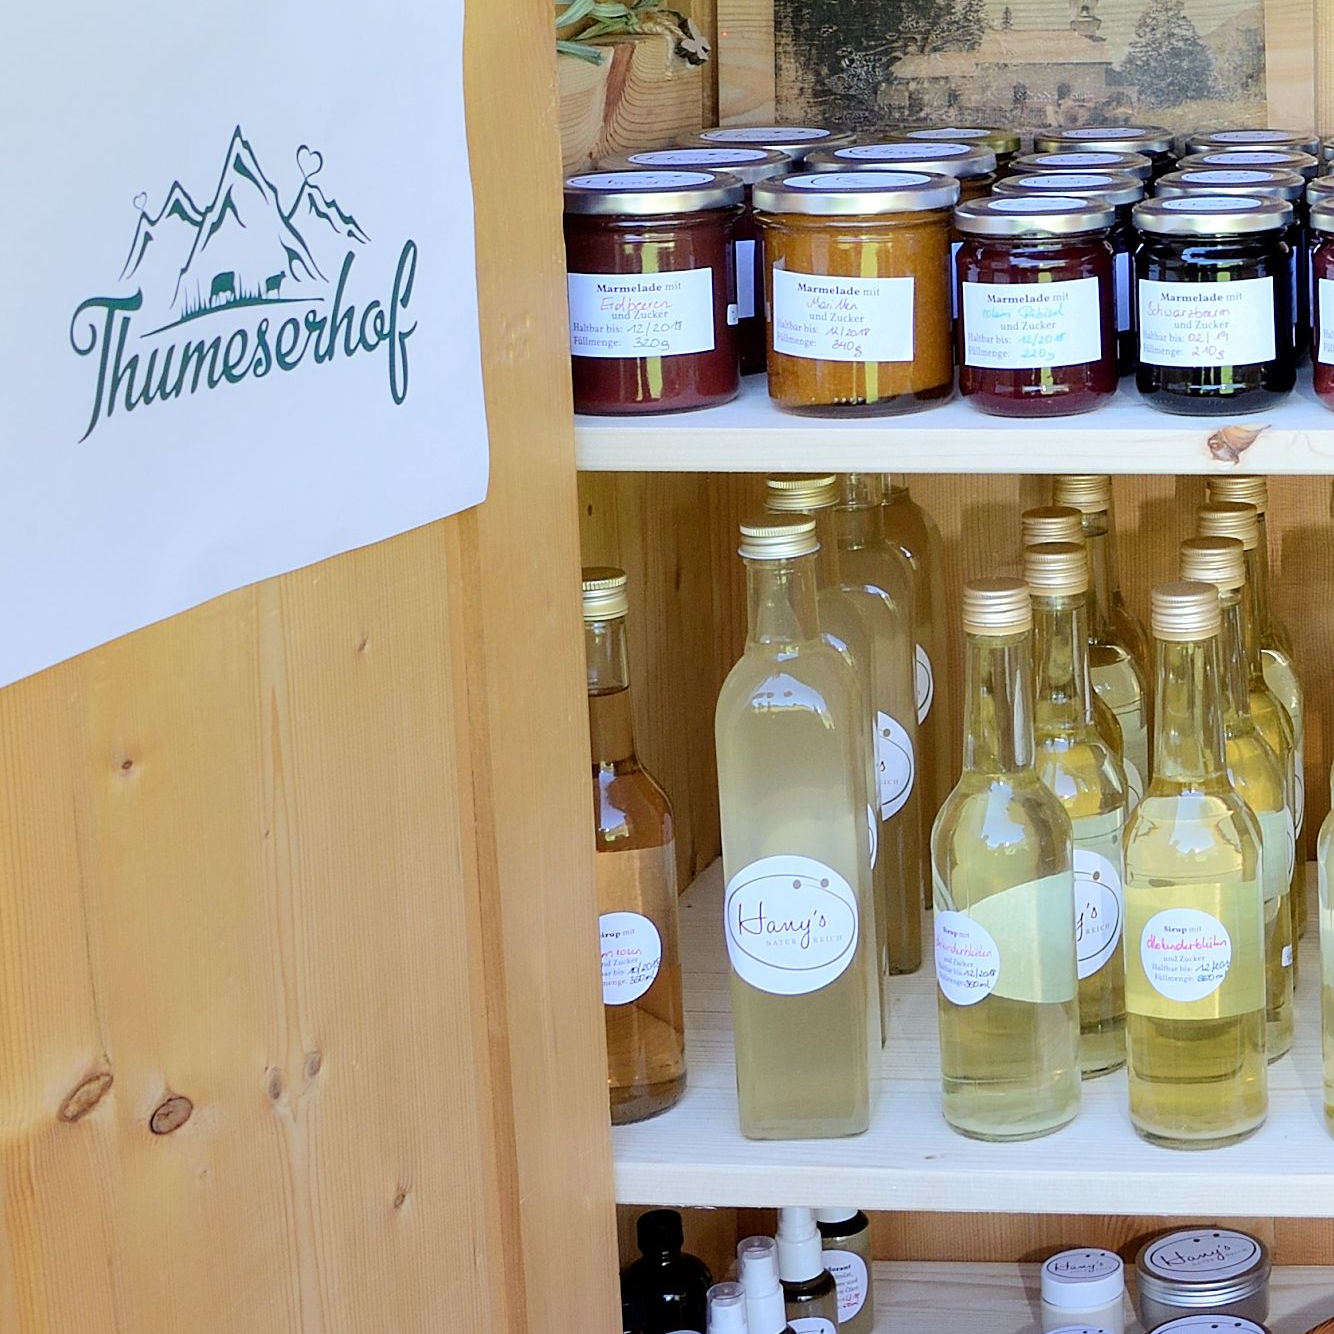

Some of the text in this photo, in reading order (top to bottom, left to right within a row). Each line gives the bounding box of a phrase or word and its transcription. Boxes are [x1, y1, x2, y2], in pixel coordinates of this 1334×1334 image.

[596, 282, 681, 293] Marmelade mit
[798, 283, 880, 296] Marmelade mit
[986, 292, 1069, 303] Marmelade mit
[1160, 292, 1242, 303] Marmelade mit
[611, 310, 667, 320] und Zucker
[809, 313, 863, 323] und Zucker
[573, 323, 604, 333] Haltbar
[1000, 320, 1056, 331] und Zucker
[1174, 320, 1229, 330] und Zucker
[69, 240, 417, 444] Thumeserhof
[573, 337, 622, 348] Füllmenge:
[1164, 924, 1187, 934] Sirup
[813, 934, 843, 943] REICH
[1179, 955, 1205, 963] Zucker
